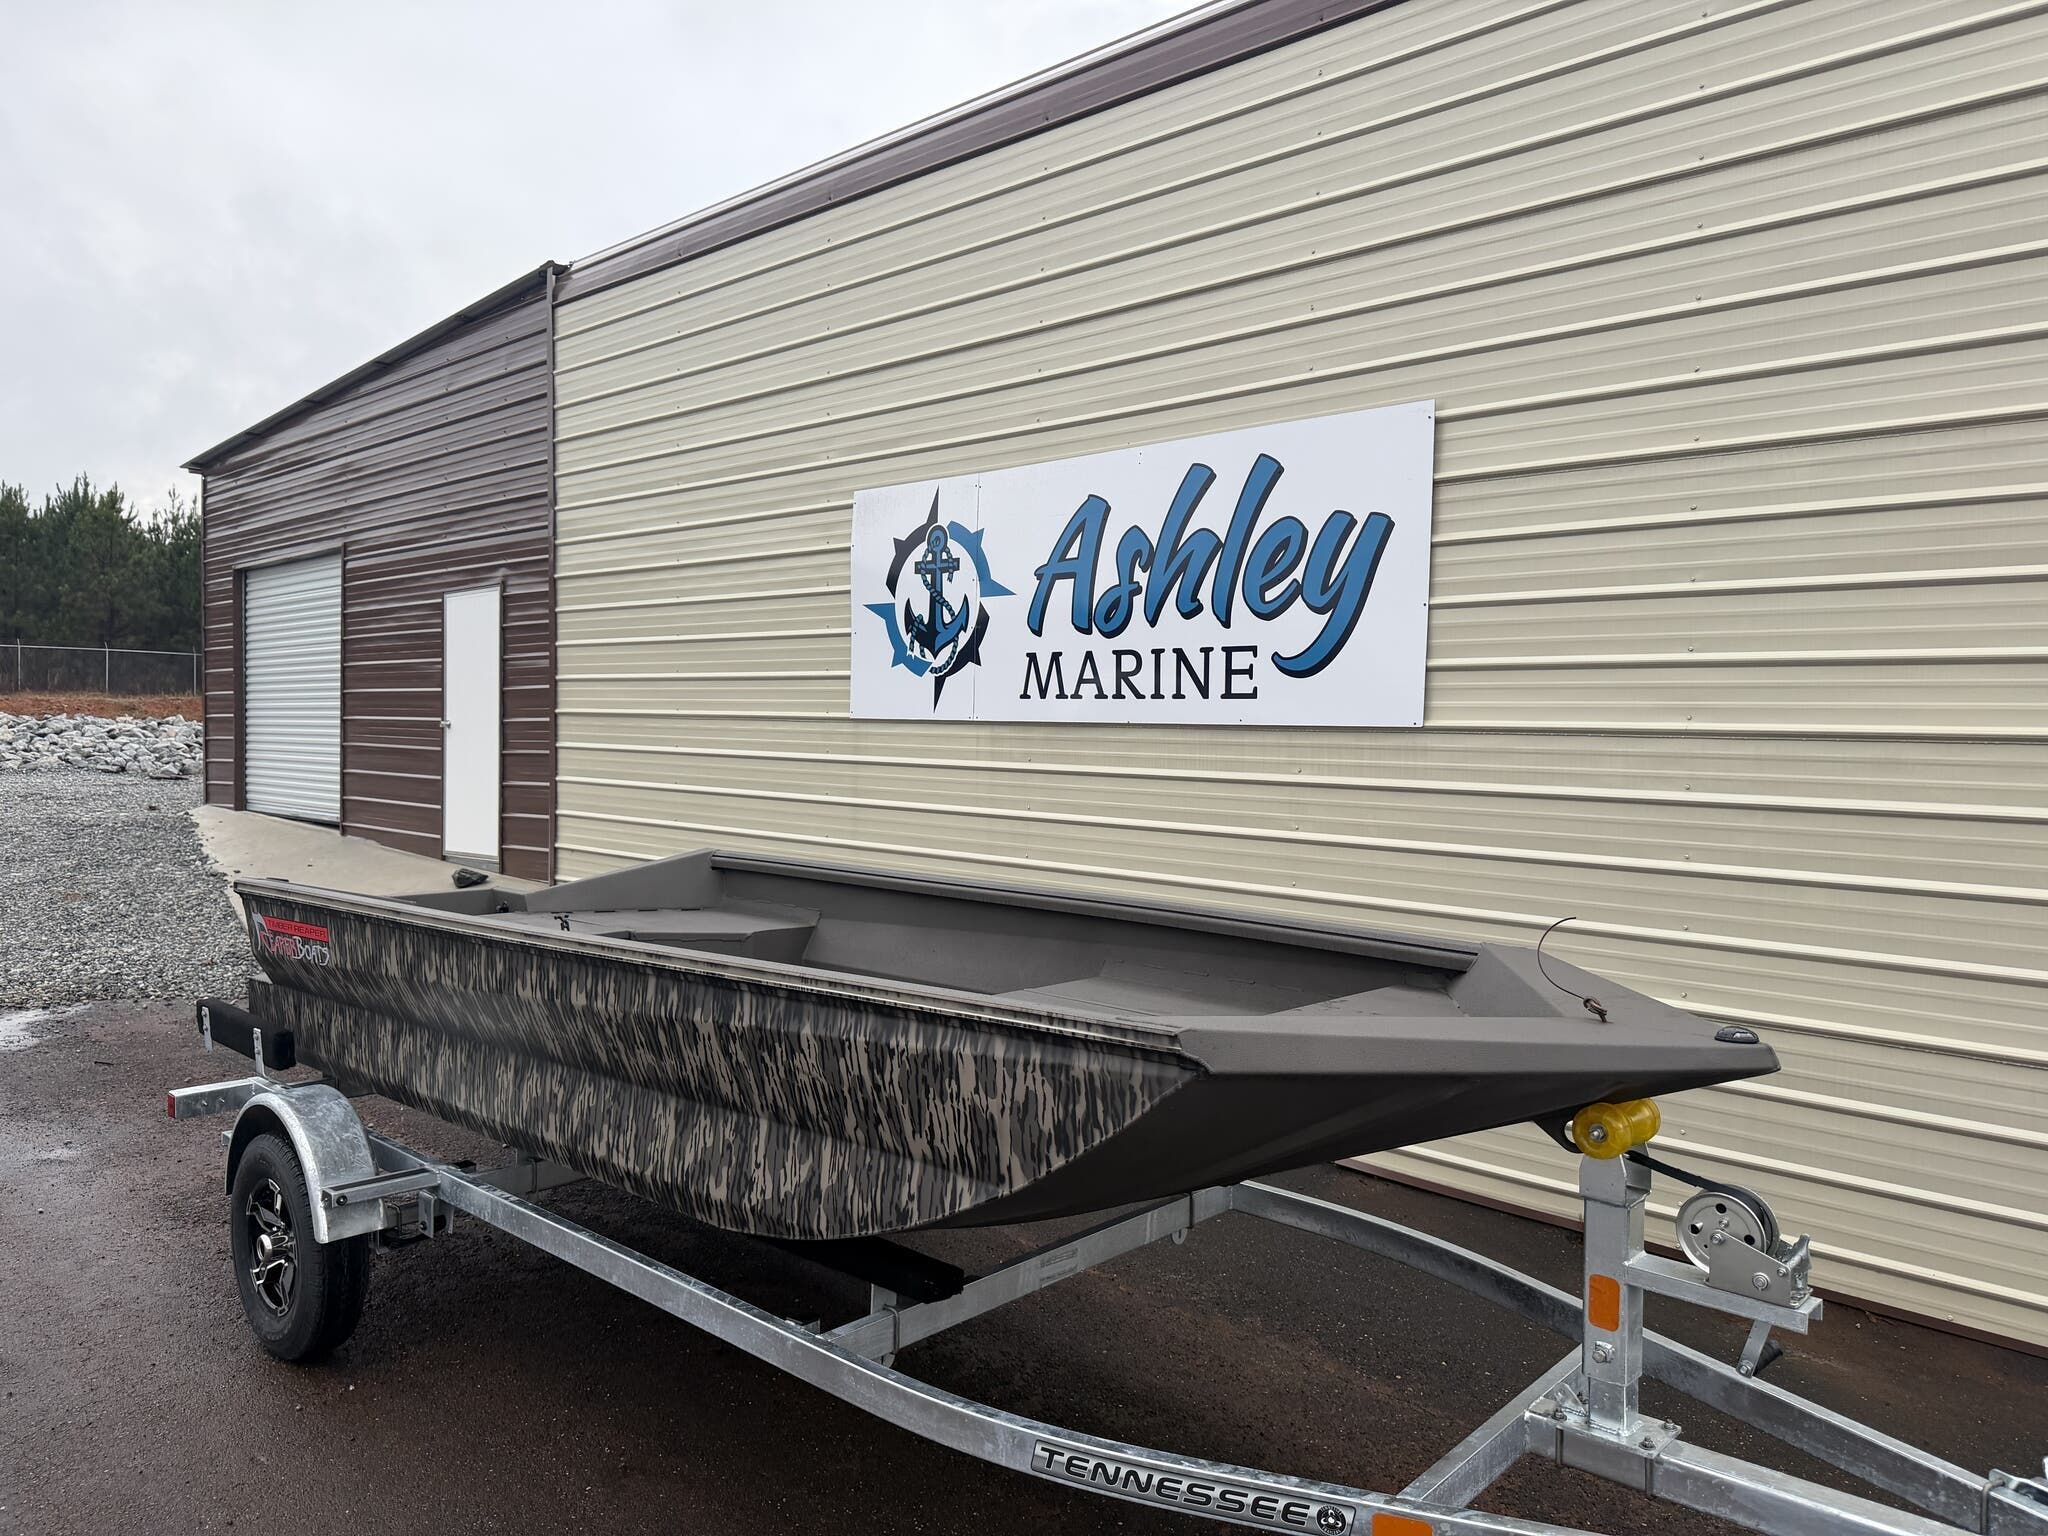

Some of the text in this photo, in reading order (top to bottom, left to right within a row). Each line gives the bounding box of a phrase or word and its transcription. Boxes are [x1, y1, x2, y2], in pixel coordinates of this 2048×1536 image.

[1028, 454, 1395, 678] Ashley
[1020, 645, 1259, 700] MARINE
[267, 919, 326, 938] TIMBER REAPER
[1040, 1446, 1311, 1526] TENNESSEE
